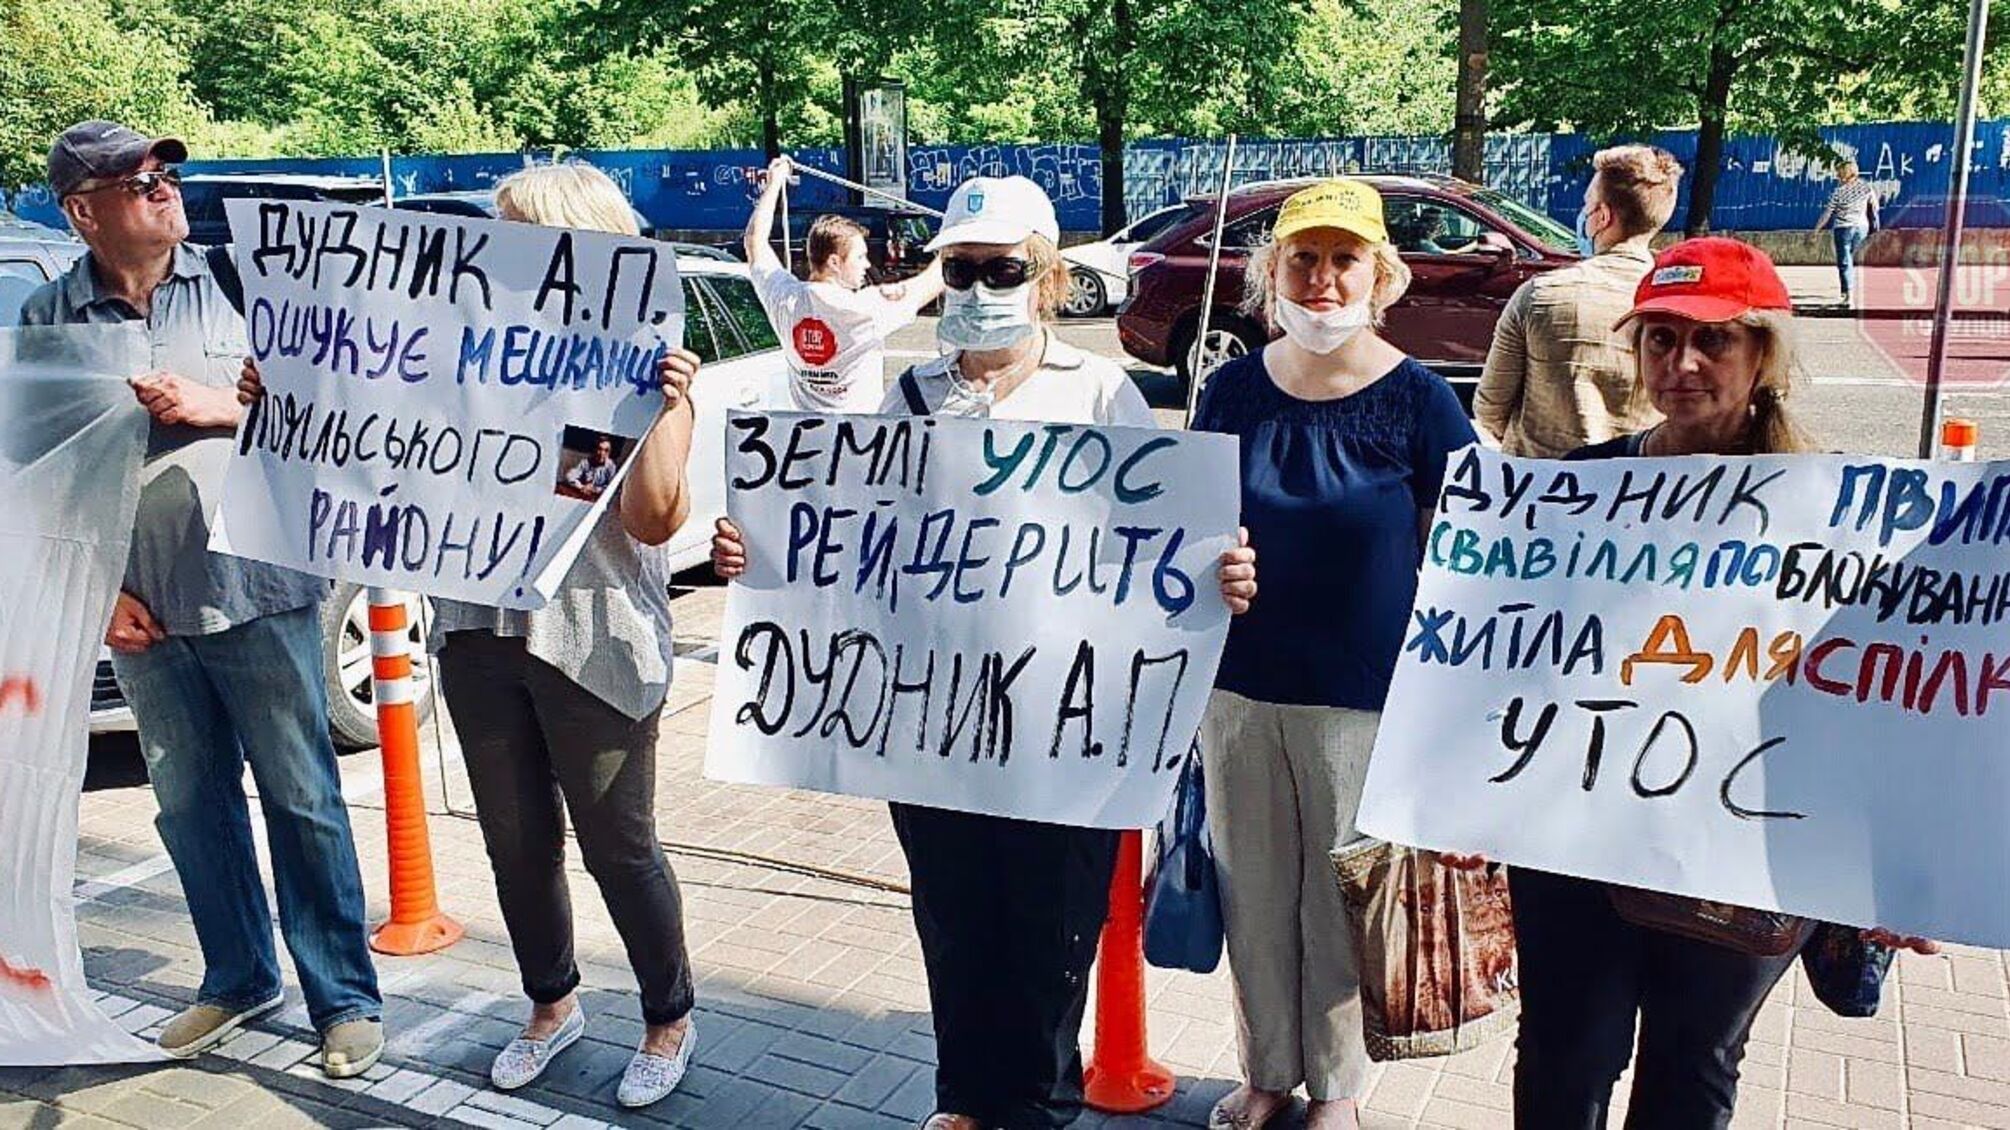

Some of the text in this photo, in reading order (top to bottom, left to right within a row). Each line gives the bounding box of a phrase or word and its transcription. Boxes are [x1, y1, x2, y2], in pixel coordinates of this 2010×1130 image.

[252, 203, 667, 330] ДУДНИК А.П.
[251, 297, 666, 396] ОШУКУЄ МЕШКАНЦІ
[731, 417, 1179, 504] ЗЕМЛІ УТОС
[1441, 446, 1788, 535] ДУДНИК
[308, 483, 546, 598] РАЙОНУ!
[736, 620, 1189, 773] ДУДНИК А.П.
[1405, 603, 1606, 676] ЖИТЛА
[1621, 614, 1804, 687] ДЛЯ
[1487, 696, 1809, 821] УТОС
